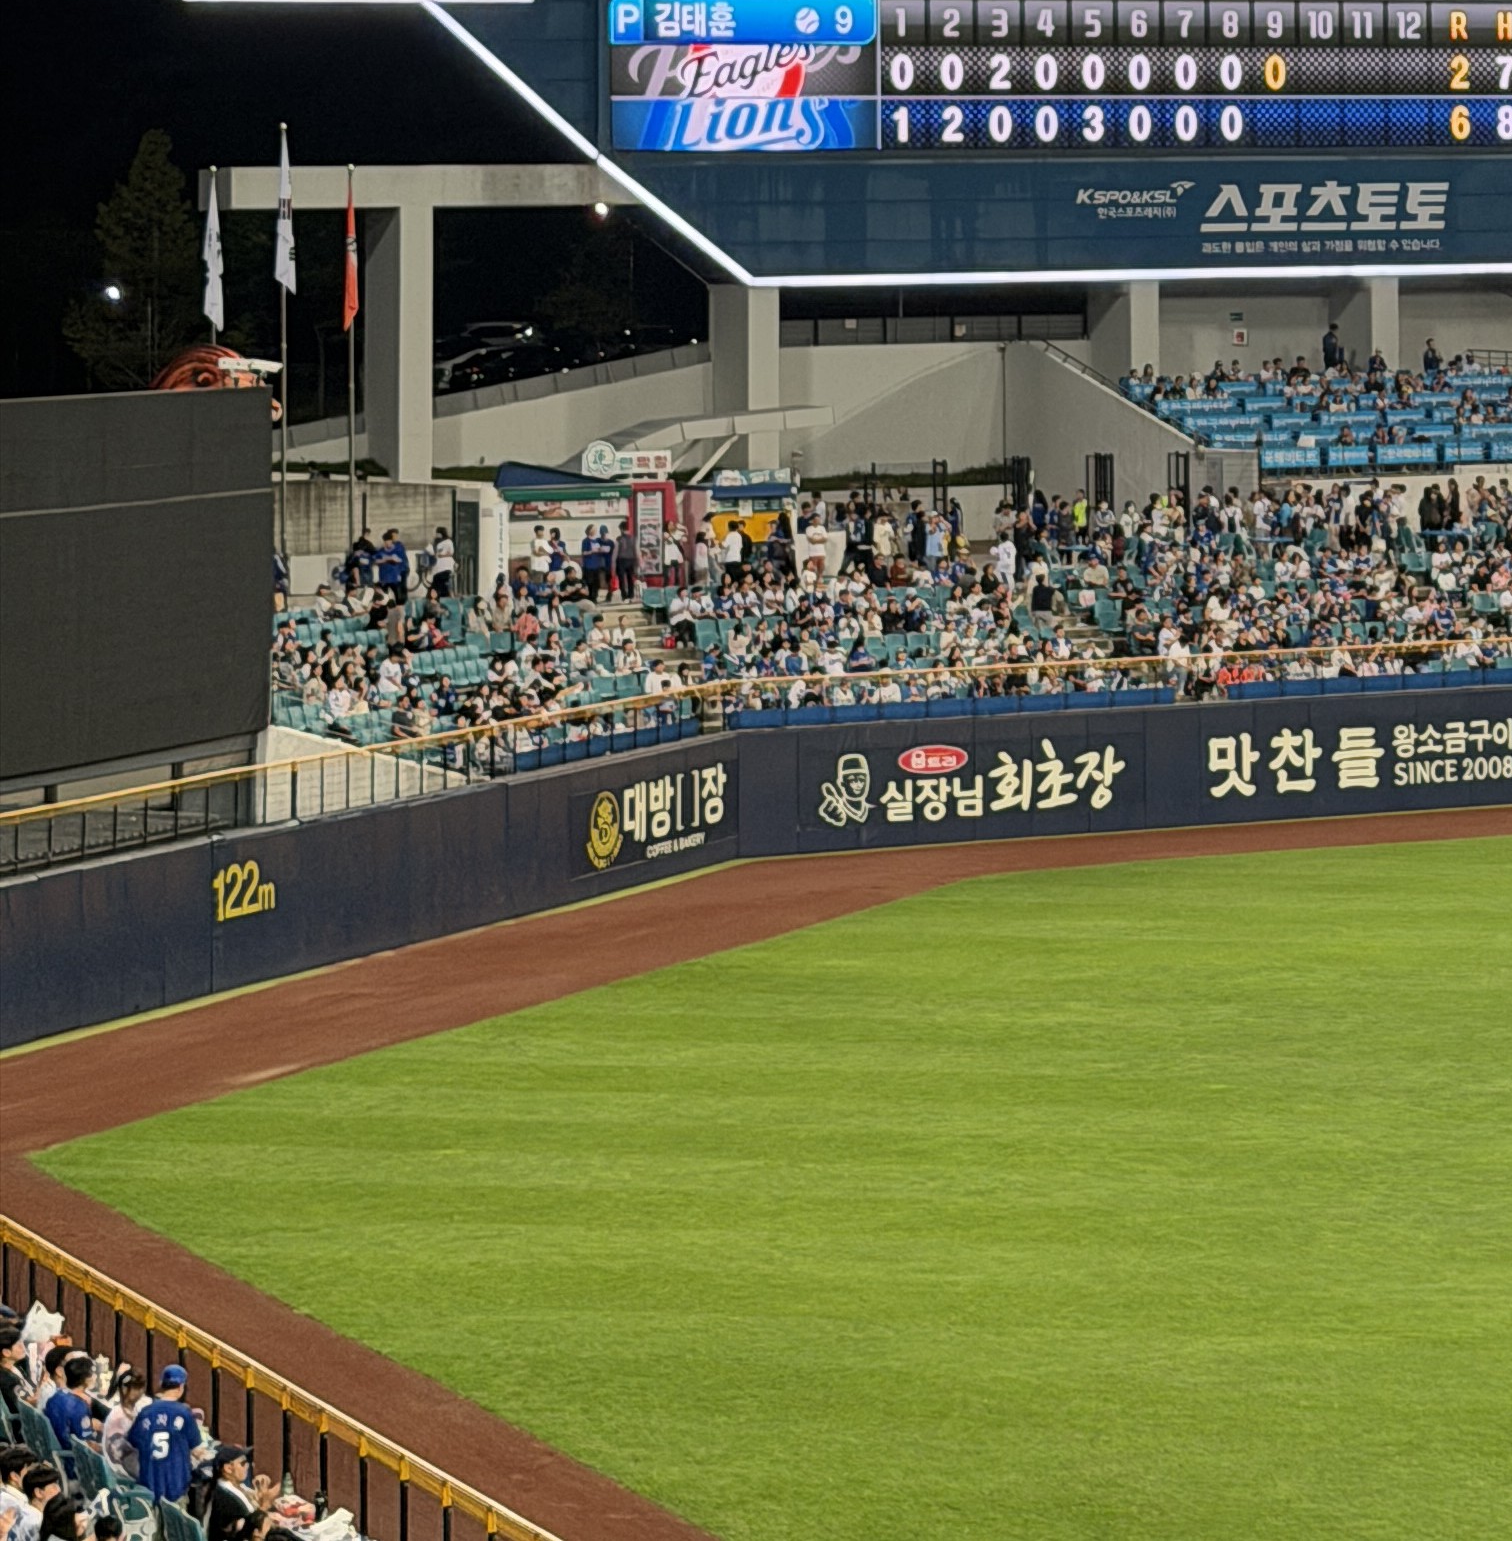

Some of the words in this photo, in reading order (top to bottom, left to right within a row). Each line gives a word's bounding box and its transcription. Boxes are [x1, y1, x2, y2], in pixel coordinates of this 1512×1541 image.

[617, 4, 640, 34] P
[654, 2, 737, 38] 김태훈
[835, 5, 853, 34] 9
[1450, 11, 1468, 41] R
[679, 43, 816, 98] Eagles
[1449, 54, 1471, 90] 2
[664, 97, 828, 150] Lions
[1076, 188, 1177, 204] KSPO&KSL
[1200, 180, 1450, 233] 스포츠토토
[880, 774, 984, 822] 실장님
[988, 738, 1126, 812] 회초장
[1393, 761, 1458, 785] SINCE
[213, 860, 276, 922] 122m
[152, 1431, 171, 1459] 5
